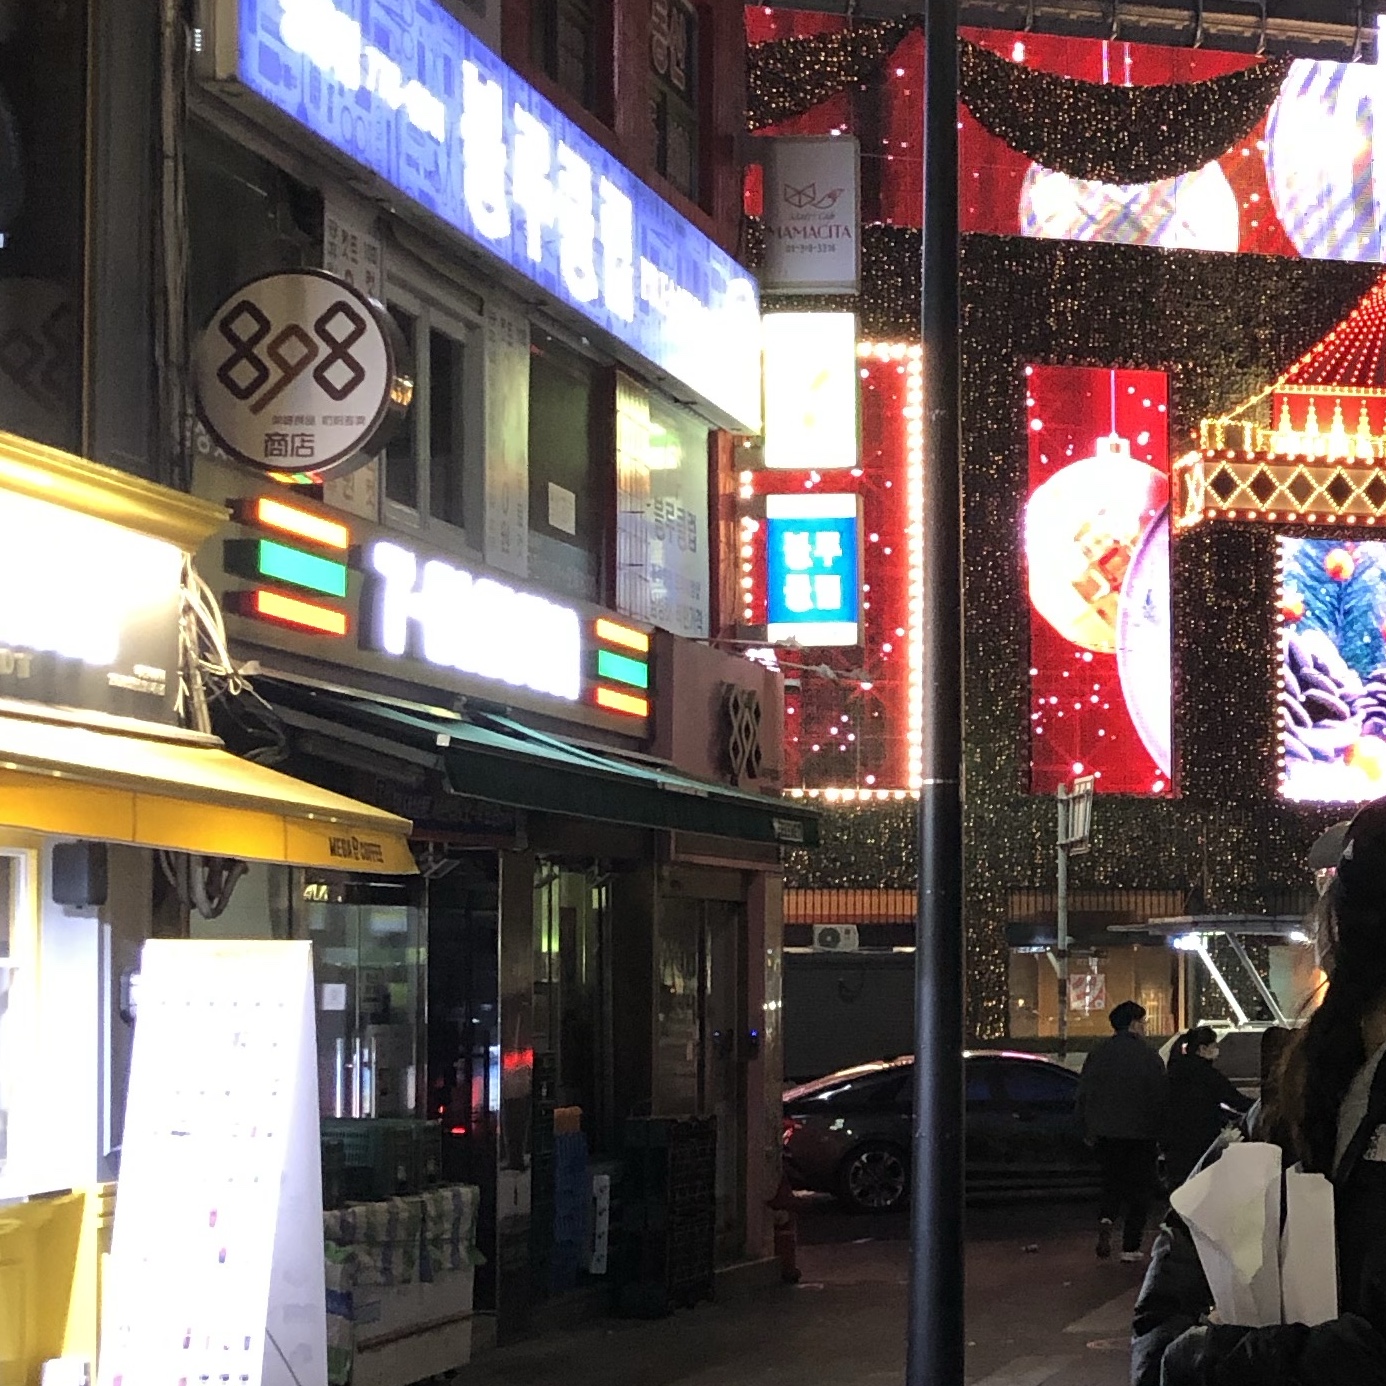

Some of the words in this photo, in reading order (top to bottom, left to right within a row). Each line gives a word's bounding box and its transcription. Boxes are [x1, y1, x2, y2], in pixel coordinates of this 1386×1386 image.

[767, 224, 852, 240] MAMACITA
[216, 299, 368, 416] 898
[264, 432, 315, 458] 商店
